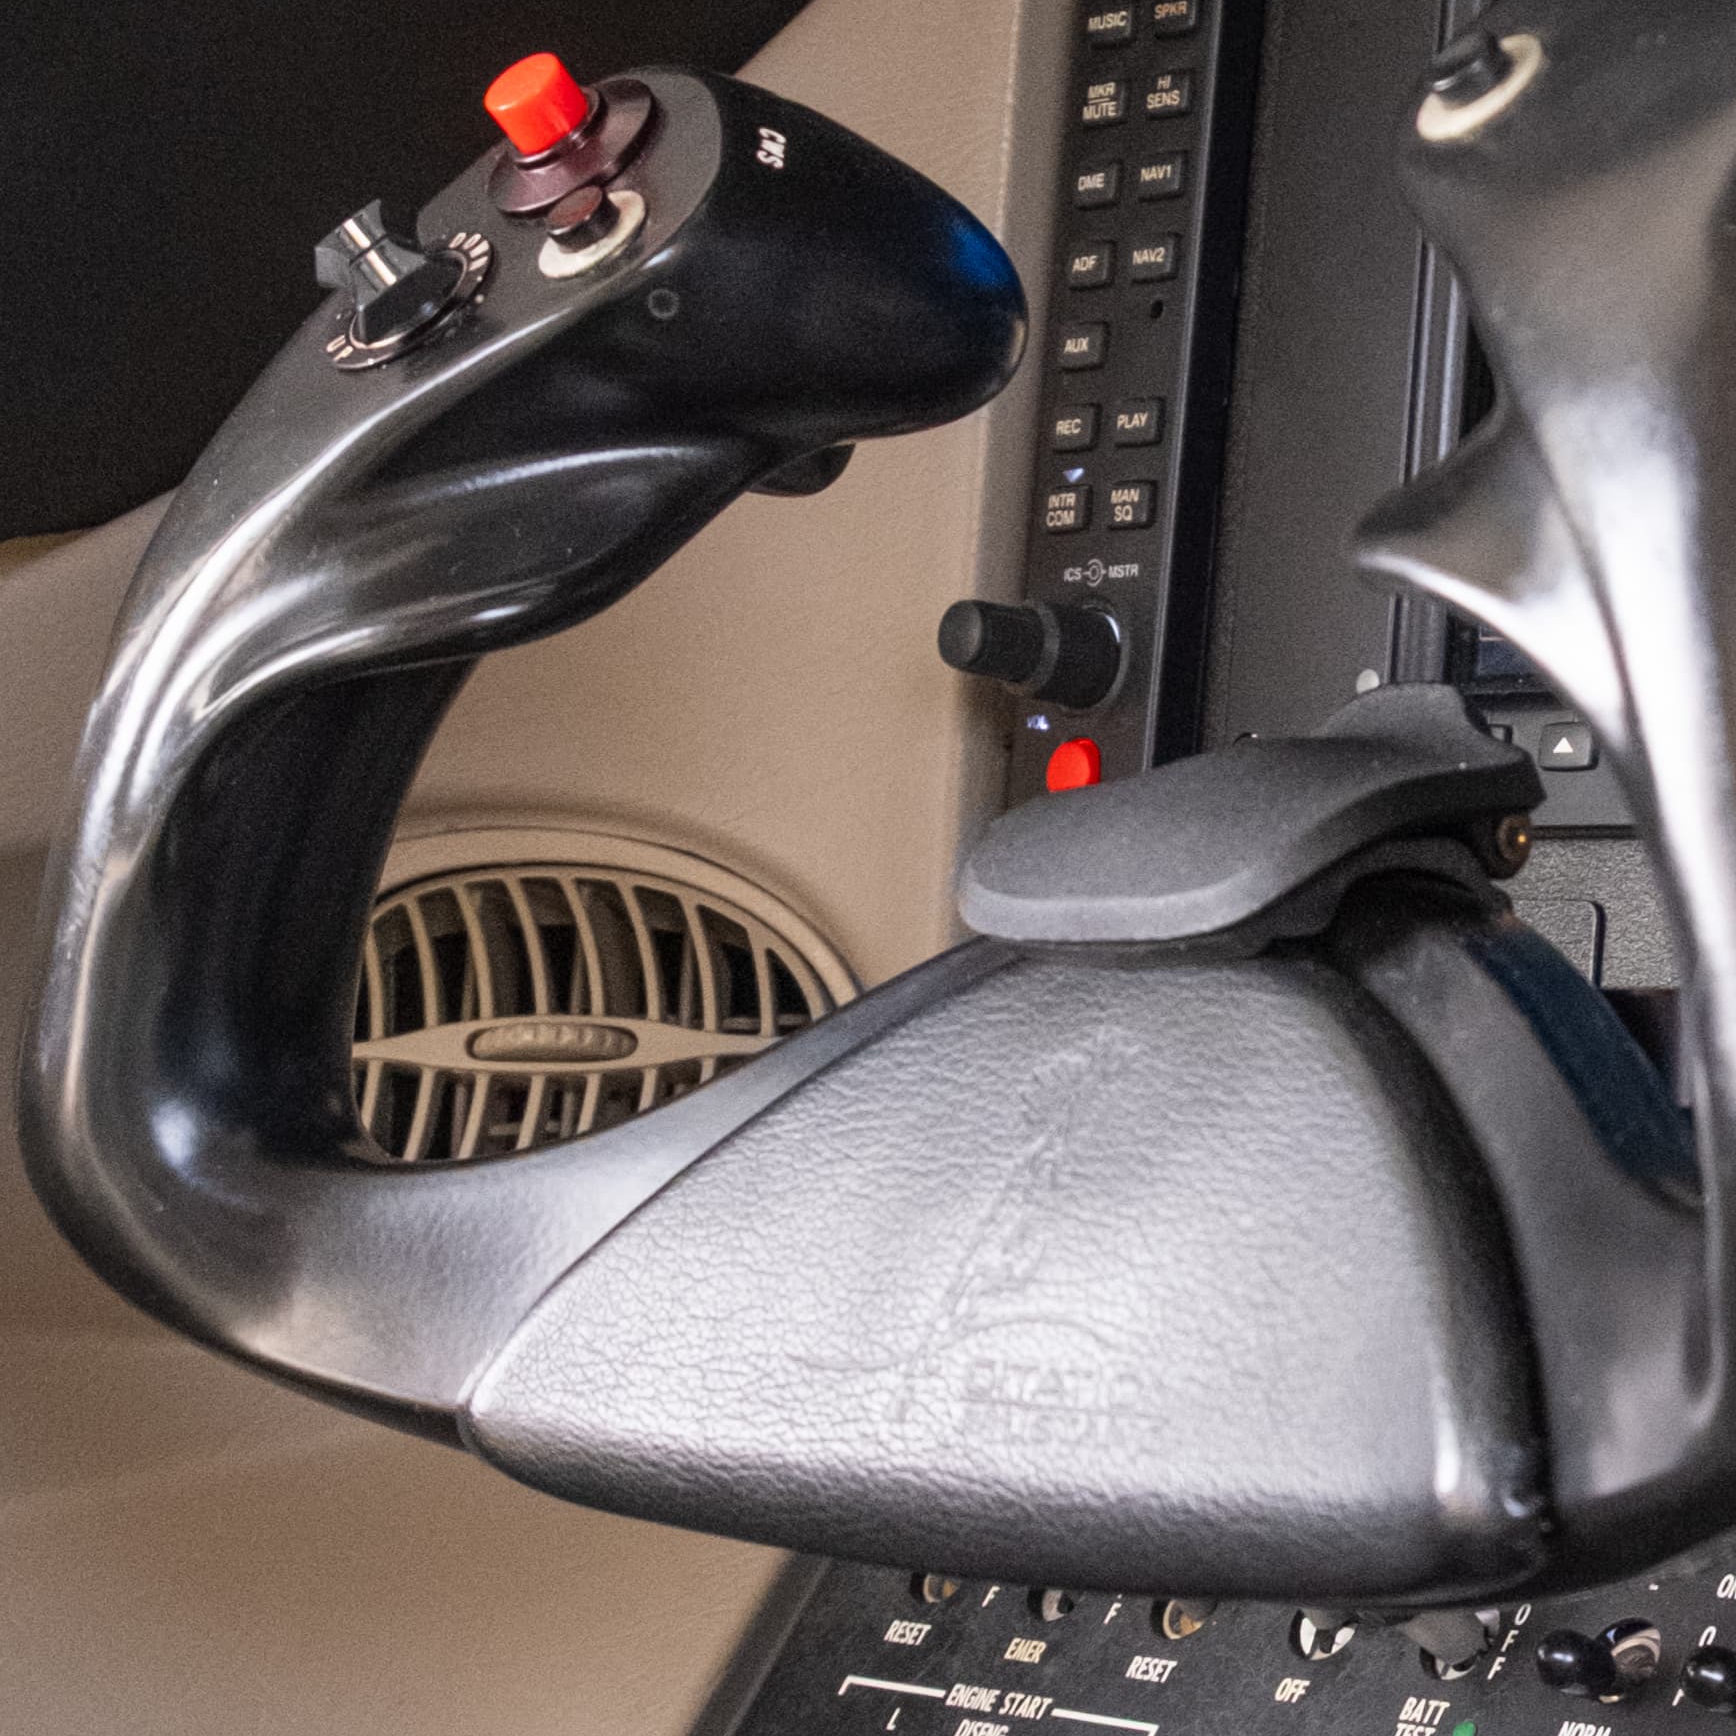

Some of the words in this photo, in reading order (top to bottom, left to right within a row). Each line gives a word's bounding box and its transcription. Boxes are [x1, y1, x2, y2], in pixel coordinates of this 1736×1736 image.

[1088, 12, 1127, 31] MUSIC
[1154, 1, 1187, 19] SPKR
[1083, 102, 1117, 120] MUTE
[1147, 90, 1180, 109] SENS
[755, 126, 788, 169] CWS
[1140, 166, 1172, 181] NAV1
[1133, 247, 1165, 264] NAV2
[1064, 337, 1089, 353] AUX
[1055, 418, 1082, 435] REC
[1116, 413, 1148, 430] PLAY
[1111, 488, 1139, 504] MAN
[1108, 565, 1139, 579] MSTR
[884, 1620, 931, 1647] RESET
[1125, 1655, 1177, 1683] RESET
[1398, 1696, 1449, 1725] BATT
